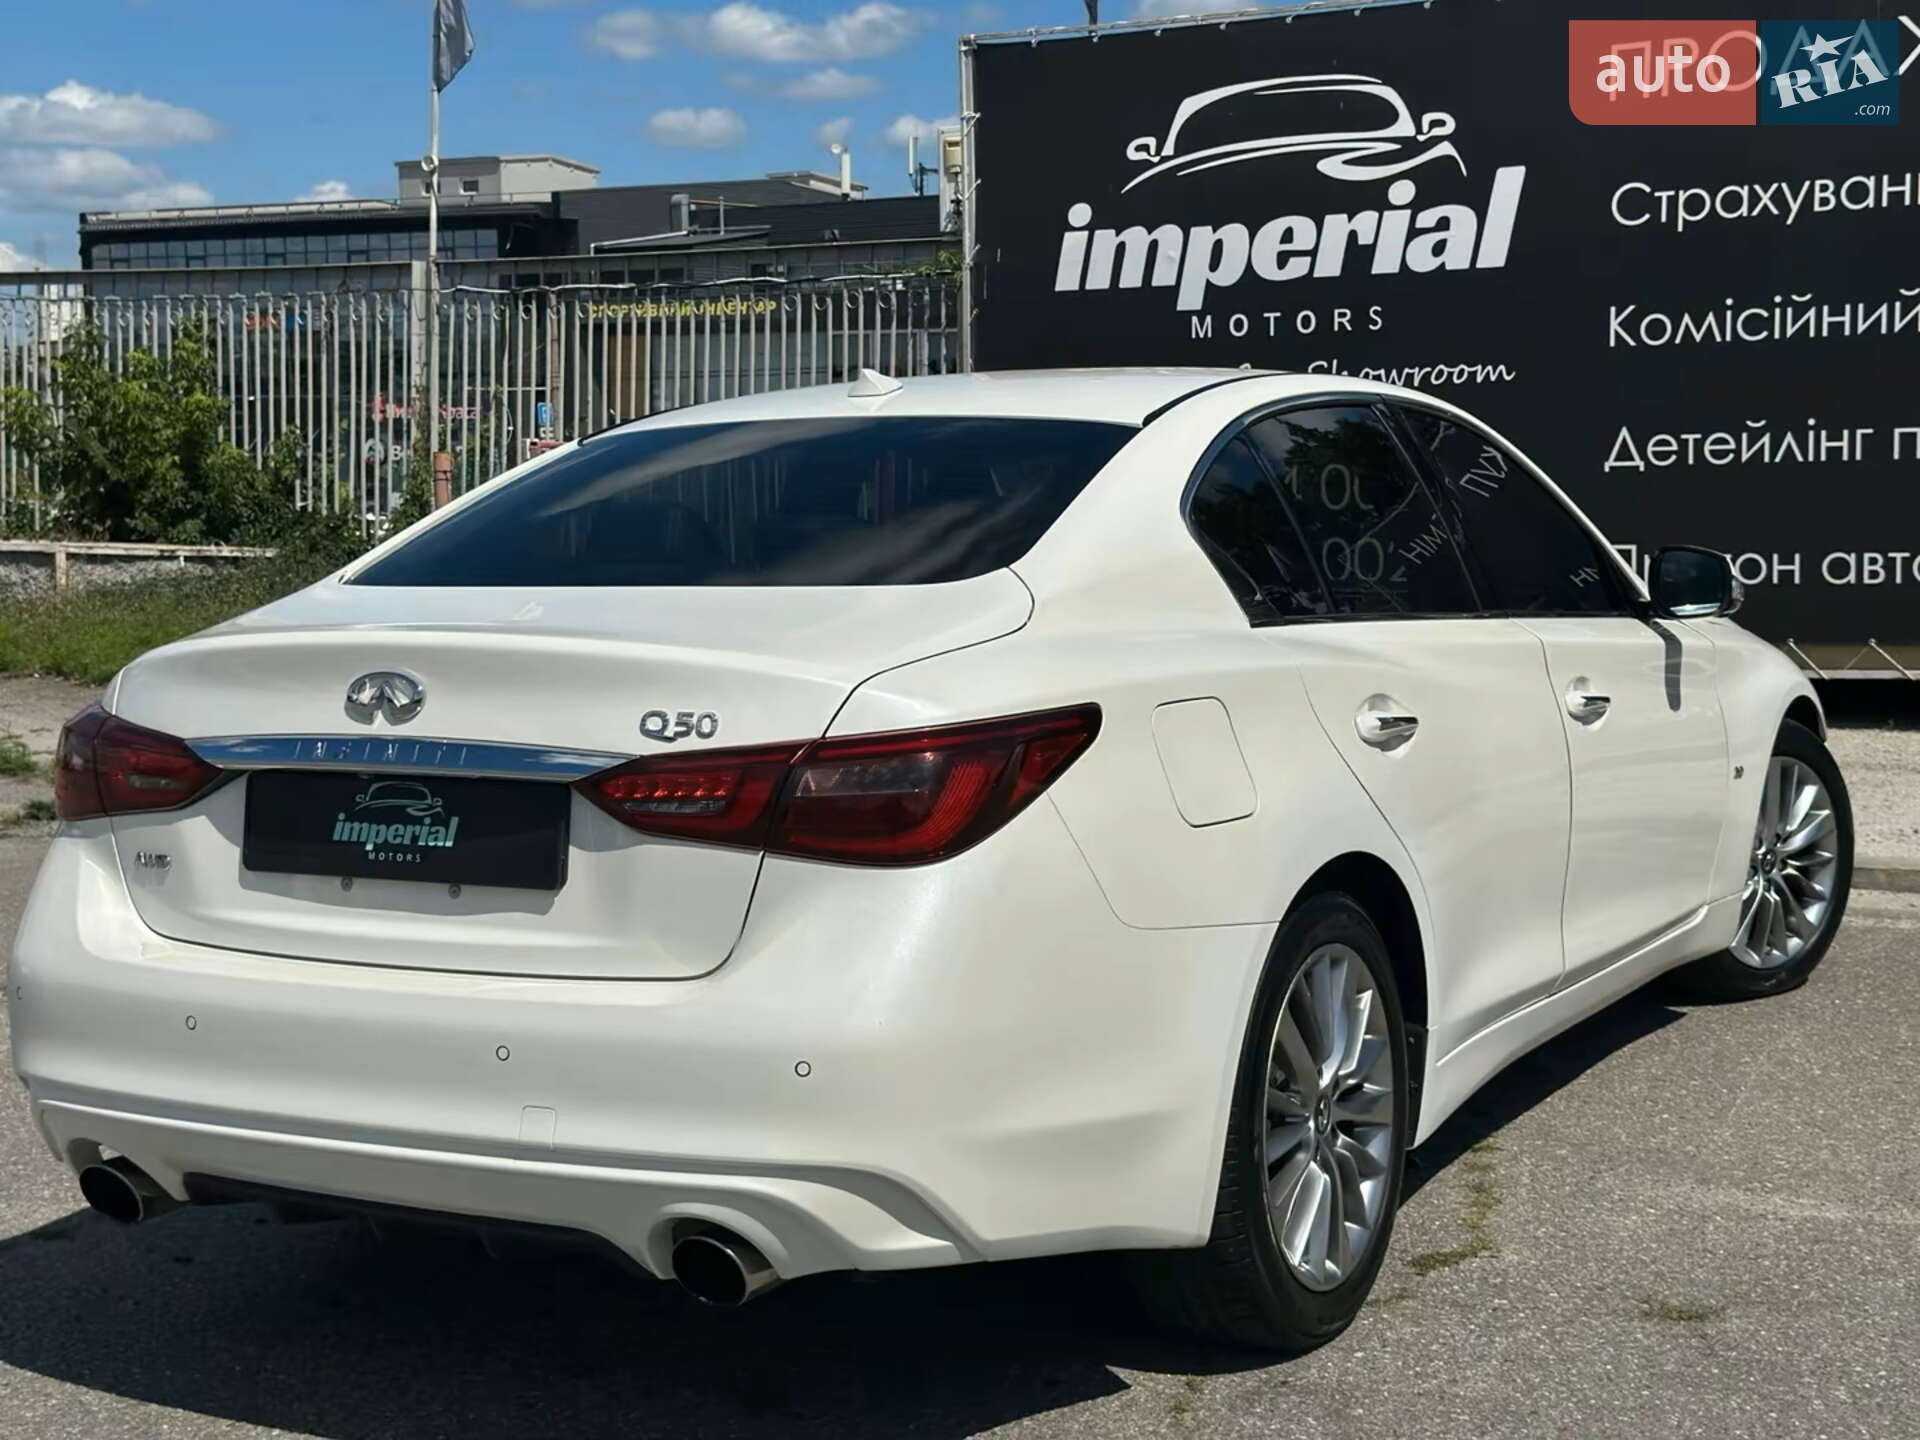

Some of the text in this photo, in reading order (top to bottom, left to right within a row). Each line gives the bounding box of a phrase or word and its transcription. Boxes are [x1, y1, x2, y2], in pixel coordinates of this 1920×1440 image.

[1611, 171, 1920, 233] Страхуван
[1054, 165, 1527, 312] imperial
[1190, 305, 1384, 340] MOTORS
[1608, 287, 1920, 348] Комісійний
[1604, 417, 1875, 473] Детейлінг
[1821, 551, 1920, 585] авт
[639, 709, 719, 744] Q50
[332, 811, 460, 851] imperial
[367, 851, 432, 864] MOTORS
